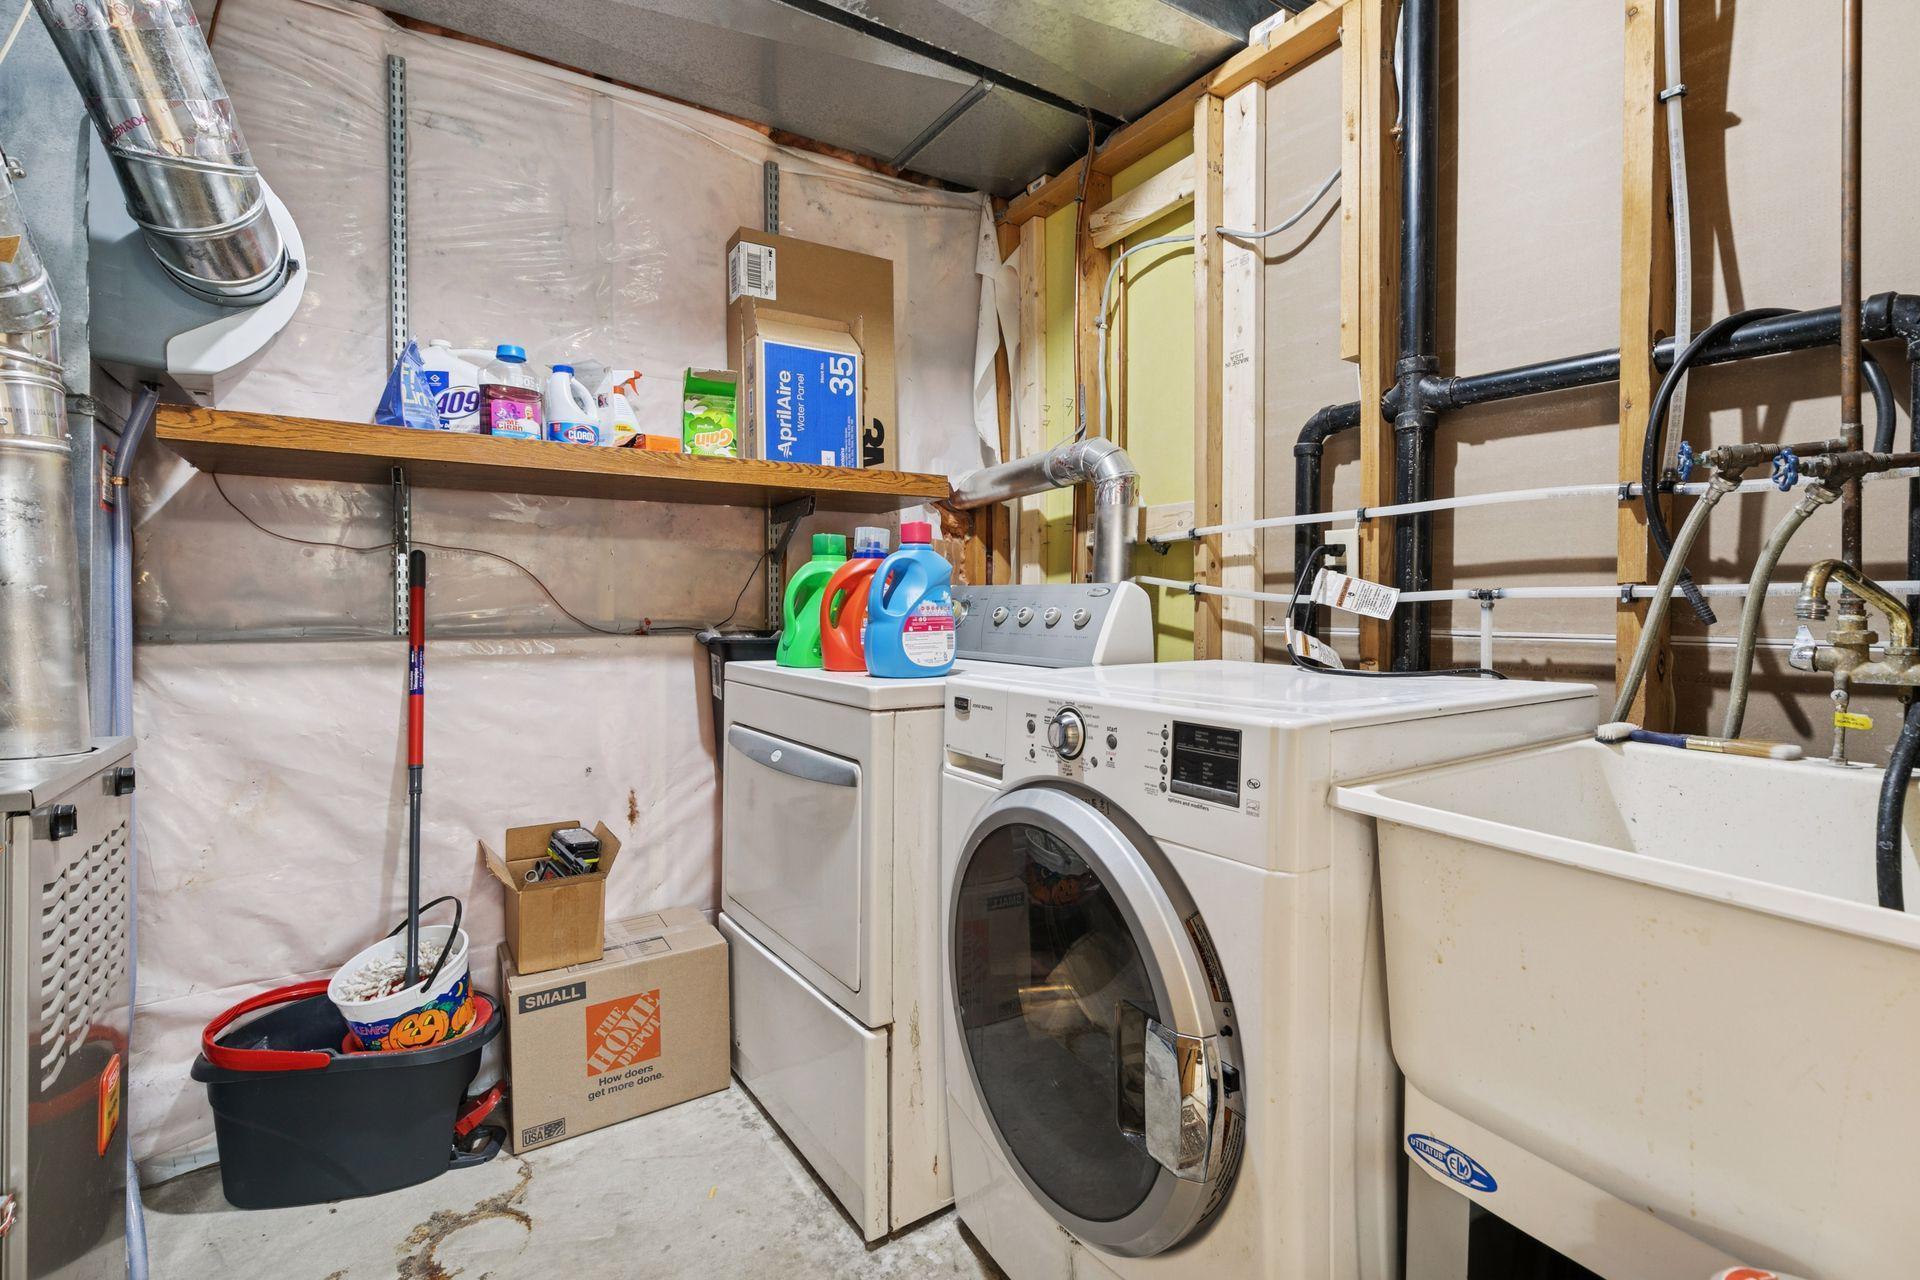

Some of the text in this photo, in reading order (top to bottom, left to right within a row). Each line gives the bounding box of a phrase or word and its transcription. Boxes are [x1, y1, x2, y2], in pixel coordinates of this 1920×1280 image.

[829, 357, 854, 397] 35
[437, 390, 480, 415] 409
[776, 370, 798, 458] AprilAire
[797, 373, 805, 432] Water Panel
[568, 430, 595, 442] CLOROX
[695, 428, 734, 448] Gain
[525, 987, 581, 1009] SMALL
[587, 991, 660, 1073] HOME
[594, 1006, 625, 1037] THE
[617, 1015, 661, 1066] DEPOT
[588, 1072, 665, 1102] get more done.
[598, 1065, 654, 1086] How doers
[525, 1131, 543, 1144] USA
[1410, 1137, 1445, 1160] UTILATUB
